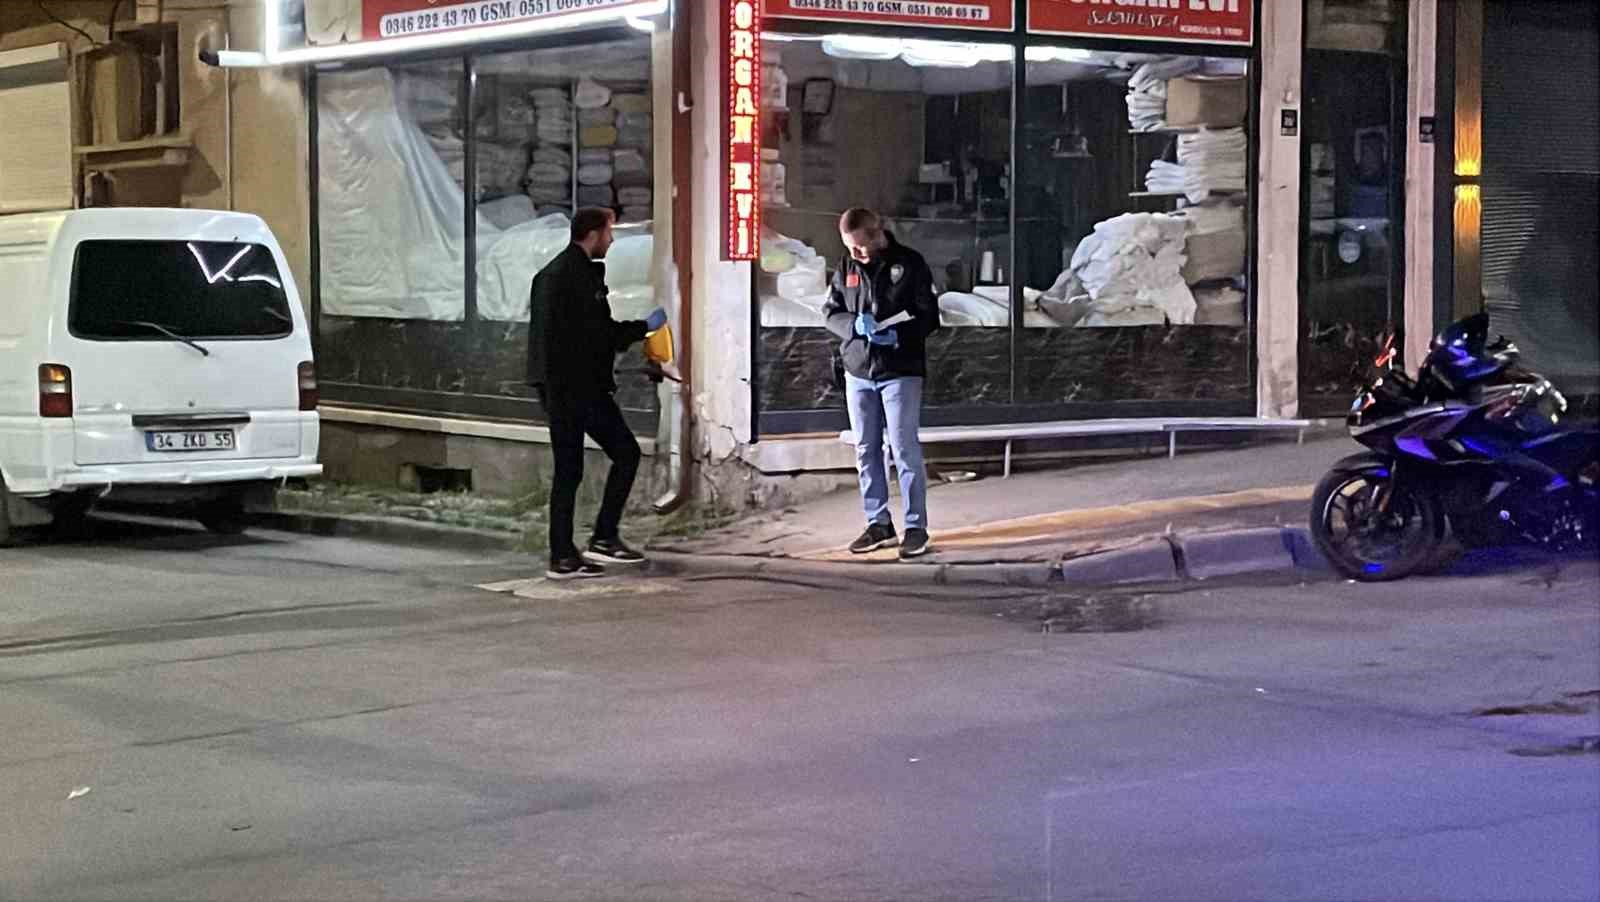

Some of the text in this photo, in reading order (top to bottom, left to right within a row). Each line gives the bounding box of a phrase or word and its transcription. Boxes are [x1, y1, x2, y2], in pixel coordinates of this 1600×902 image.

[863, 2, 875, 12] 70
[385, 17, 414, 35] 0346
[417, 12, 439, 30] 222
[443, 10, 458, 27] 43
[461, 7, 477, 24] 70
[519, 0, 551, 16] 0551
[155, 432, 231, 449] 34 ZKD 55
